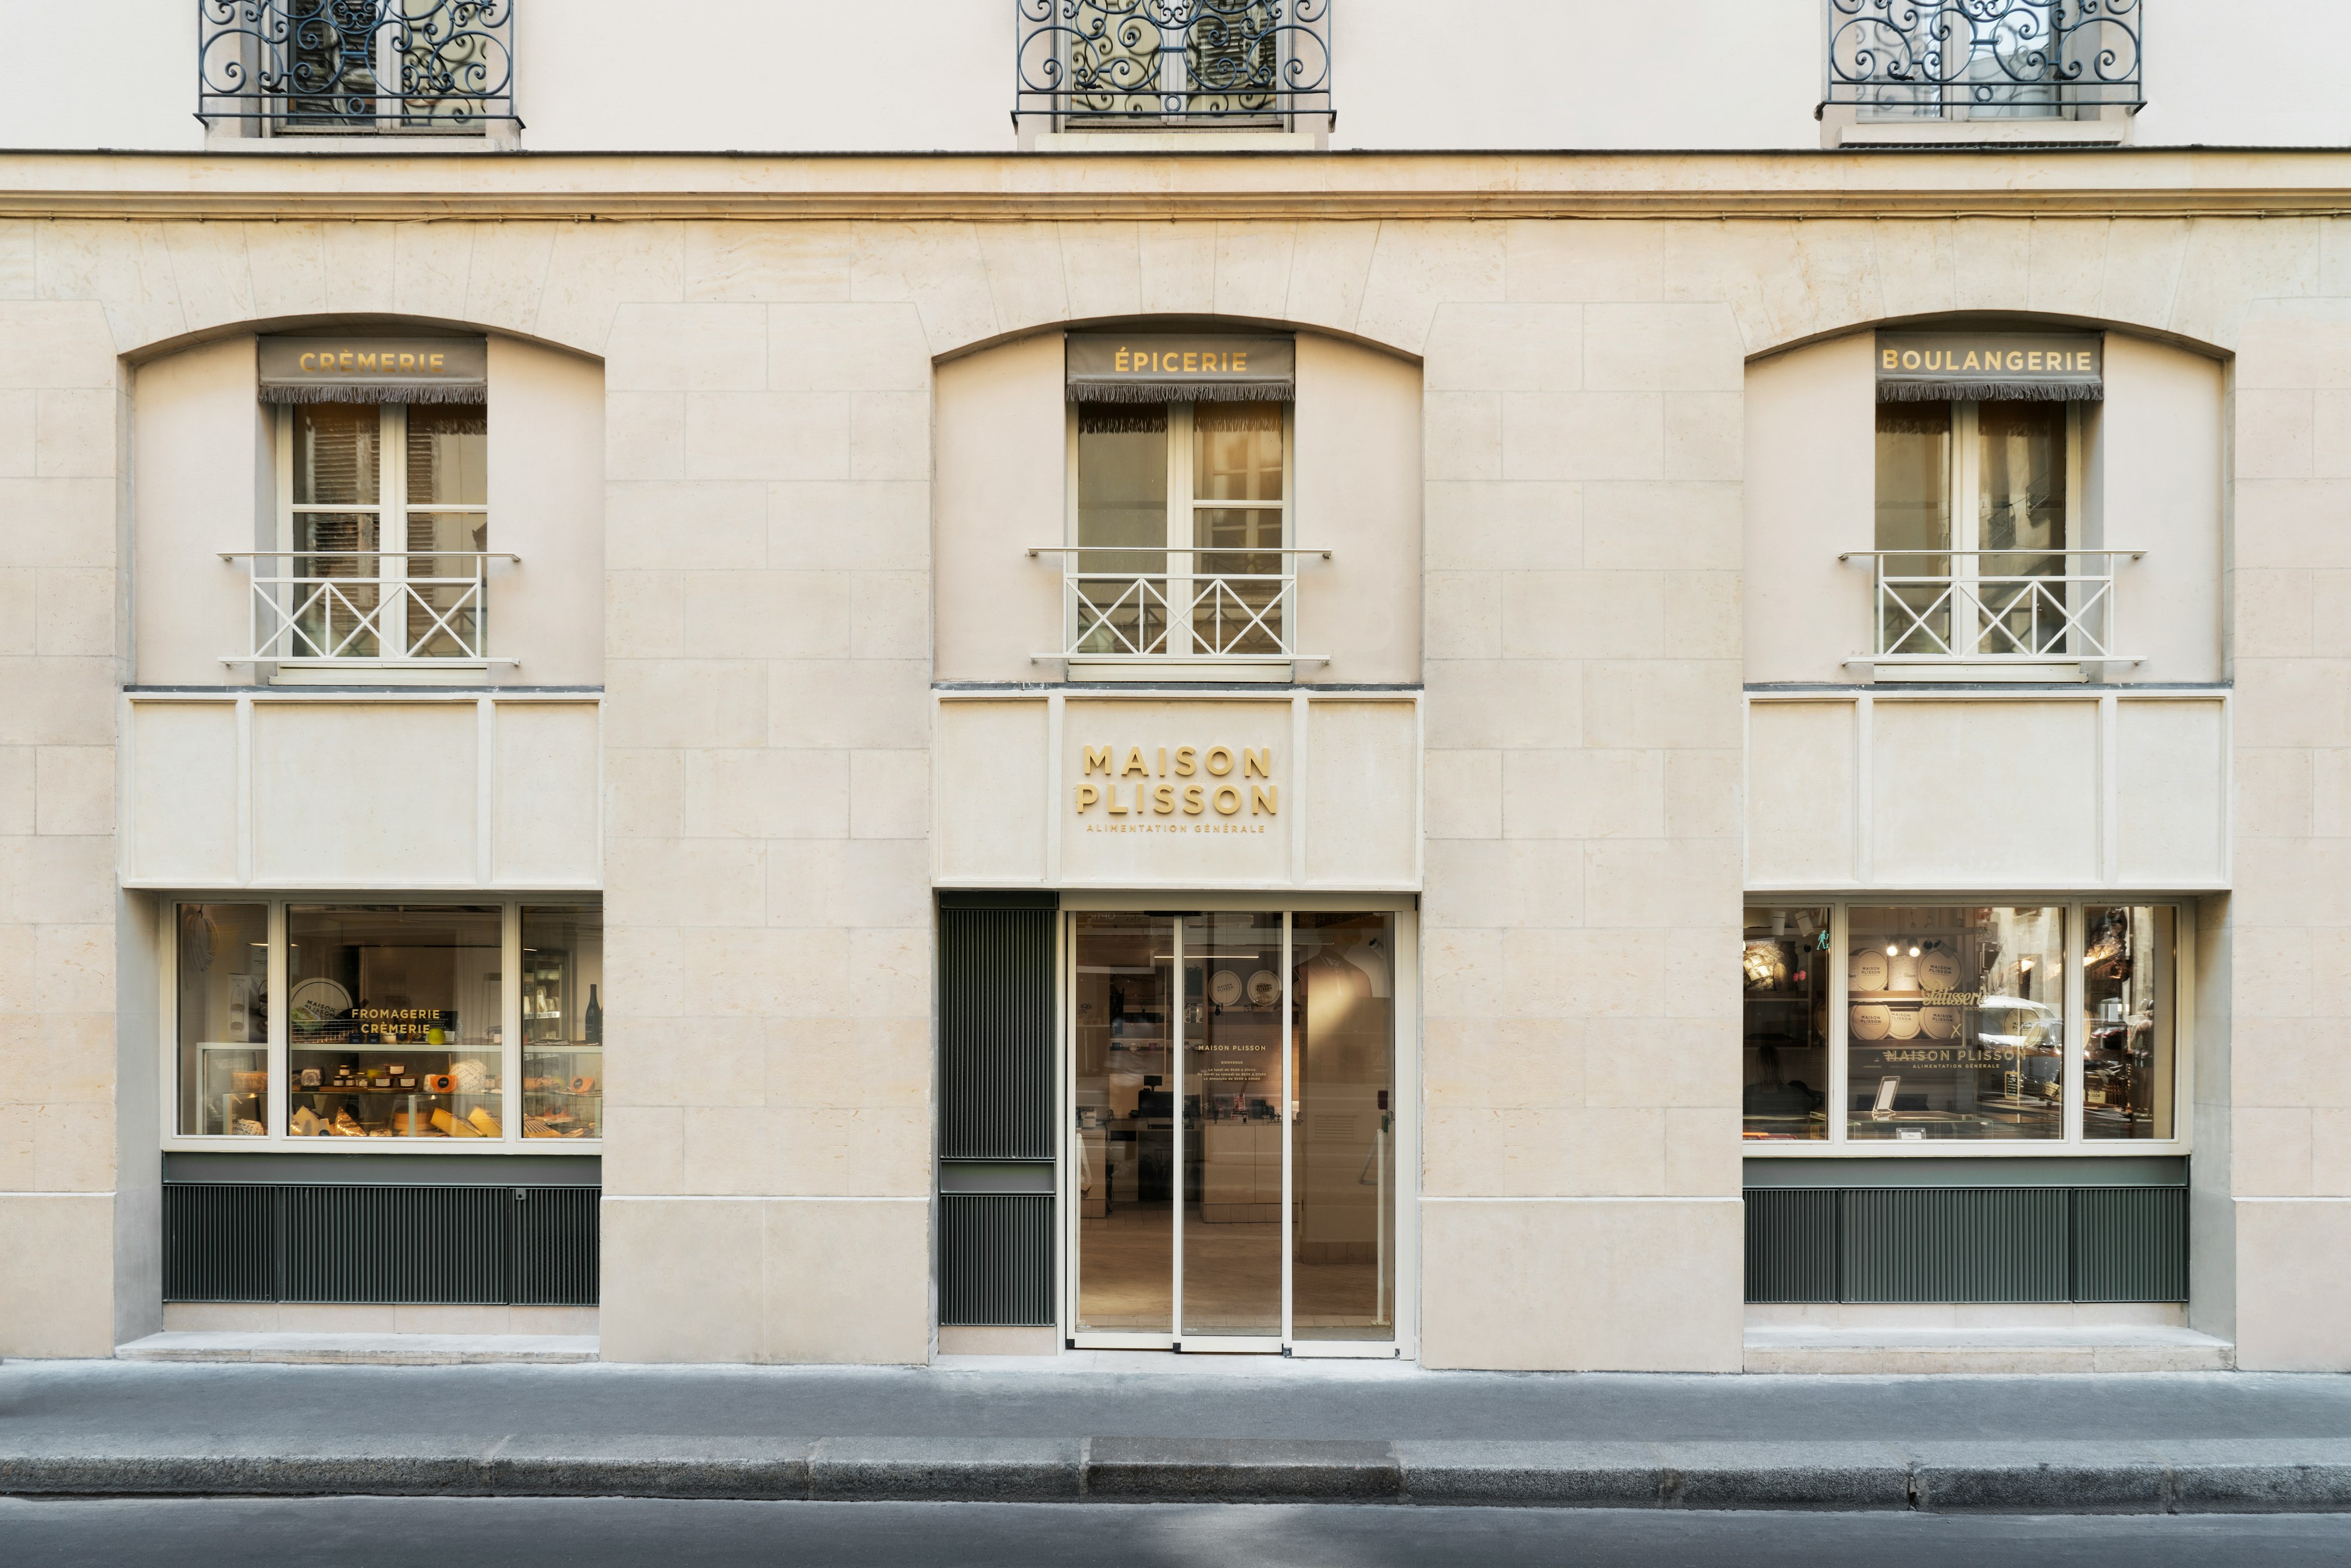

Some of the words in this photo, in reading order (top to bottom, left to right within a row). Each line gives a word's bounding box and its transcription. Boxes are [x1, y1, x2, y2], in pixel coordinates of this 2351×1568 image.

[300, 349, 445, 373] CRÈMERIE
[1115, 346, 1246, 371] ÉPICERIE
[1883, 350, 2091, 371] BOULANGERIE
[1084, 745, 1270, 777] MAISON
[1077, 784, 1277, 814] PLISSON
[1086, 824, 1187, 833] ALIMENTATION
[1195, 823, 1265, 833] GÉNÉRALE
[1921, 979, 1990, 1005] Pâtisserie
[307, 1000, 335, 1012] MAISON
[351, 1009, 440, 1019] FROMAGERIE
[361, 1022, 430, 1033] CRÈMERIE
[1886, 1050, 1949, 1061] MAISON
[1958, 1050, 2026, 1061] PLISSON
